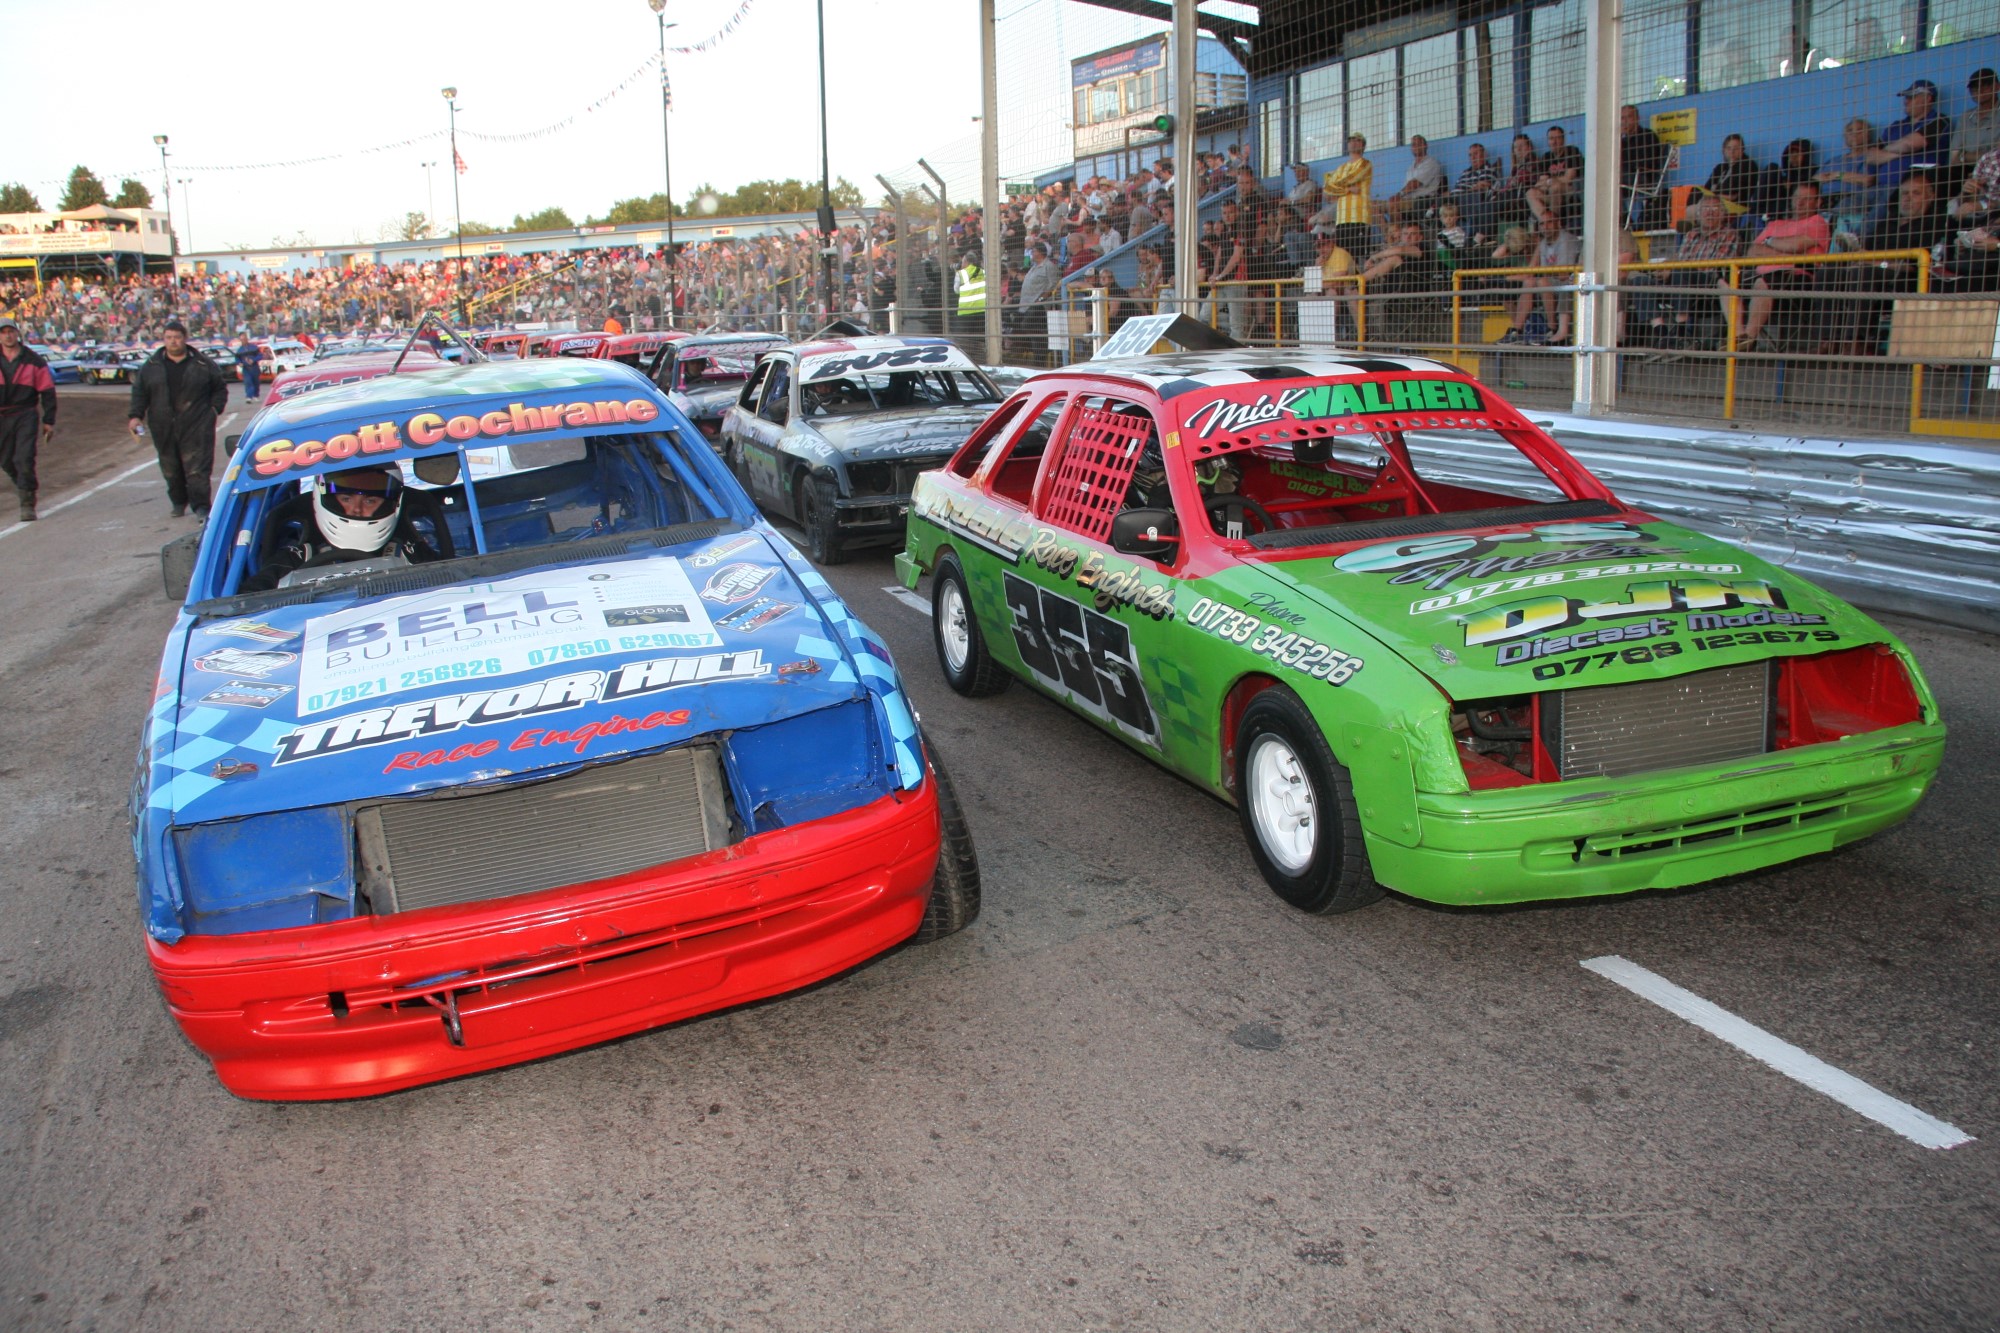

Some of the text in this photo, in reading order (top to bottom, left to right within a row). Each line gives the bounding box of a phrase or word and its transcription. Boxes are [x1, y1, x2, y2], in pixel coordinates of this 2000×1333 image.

[809, 346, 949, 380] BUZZ
[1101, 317, 1173, 357] 355
[1293, 379, 1482, 419] WALKER
[253, 398, 660, 475] Scott Cochrane
[1025, 527, 1079, 577] Race
[1076, 551, 1175, 616] Engines
[1417, 571, 1566, 612] 01778
[325, 609, 583, 670] BUILDING
[326, 590, 579, 654] BELL
[1243, 592, 1307, 626] Phone
[1457, 578, 1782, 647] DJH
[1495, 609, 1828, 666] Diecast Models
[307, 677, 387, 711] 07921
[400, 657, 502, 688] 256826
[527, 638, 612, 666] 07850
[618, 632, 715, 650] 629067
[1001, 568, 1160, 740] 355
[1187, 597, 1365, 687] 01733 345256
[273, 648, 772, 766] TREVOR HILL
[382, 708, 691, 775] Race Engines
